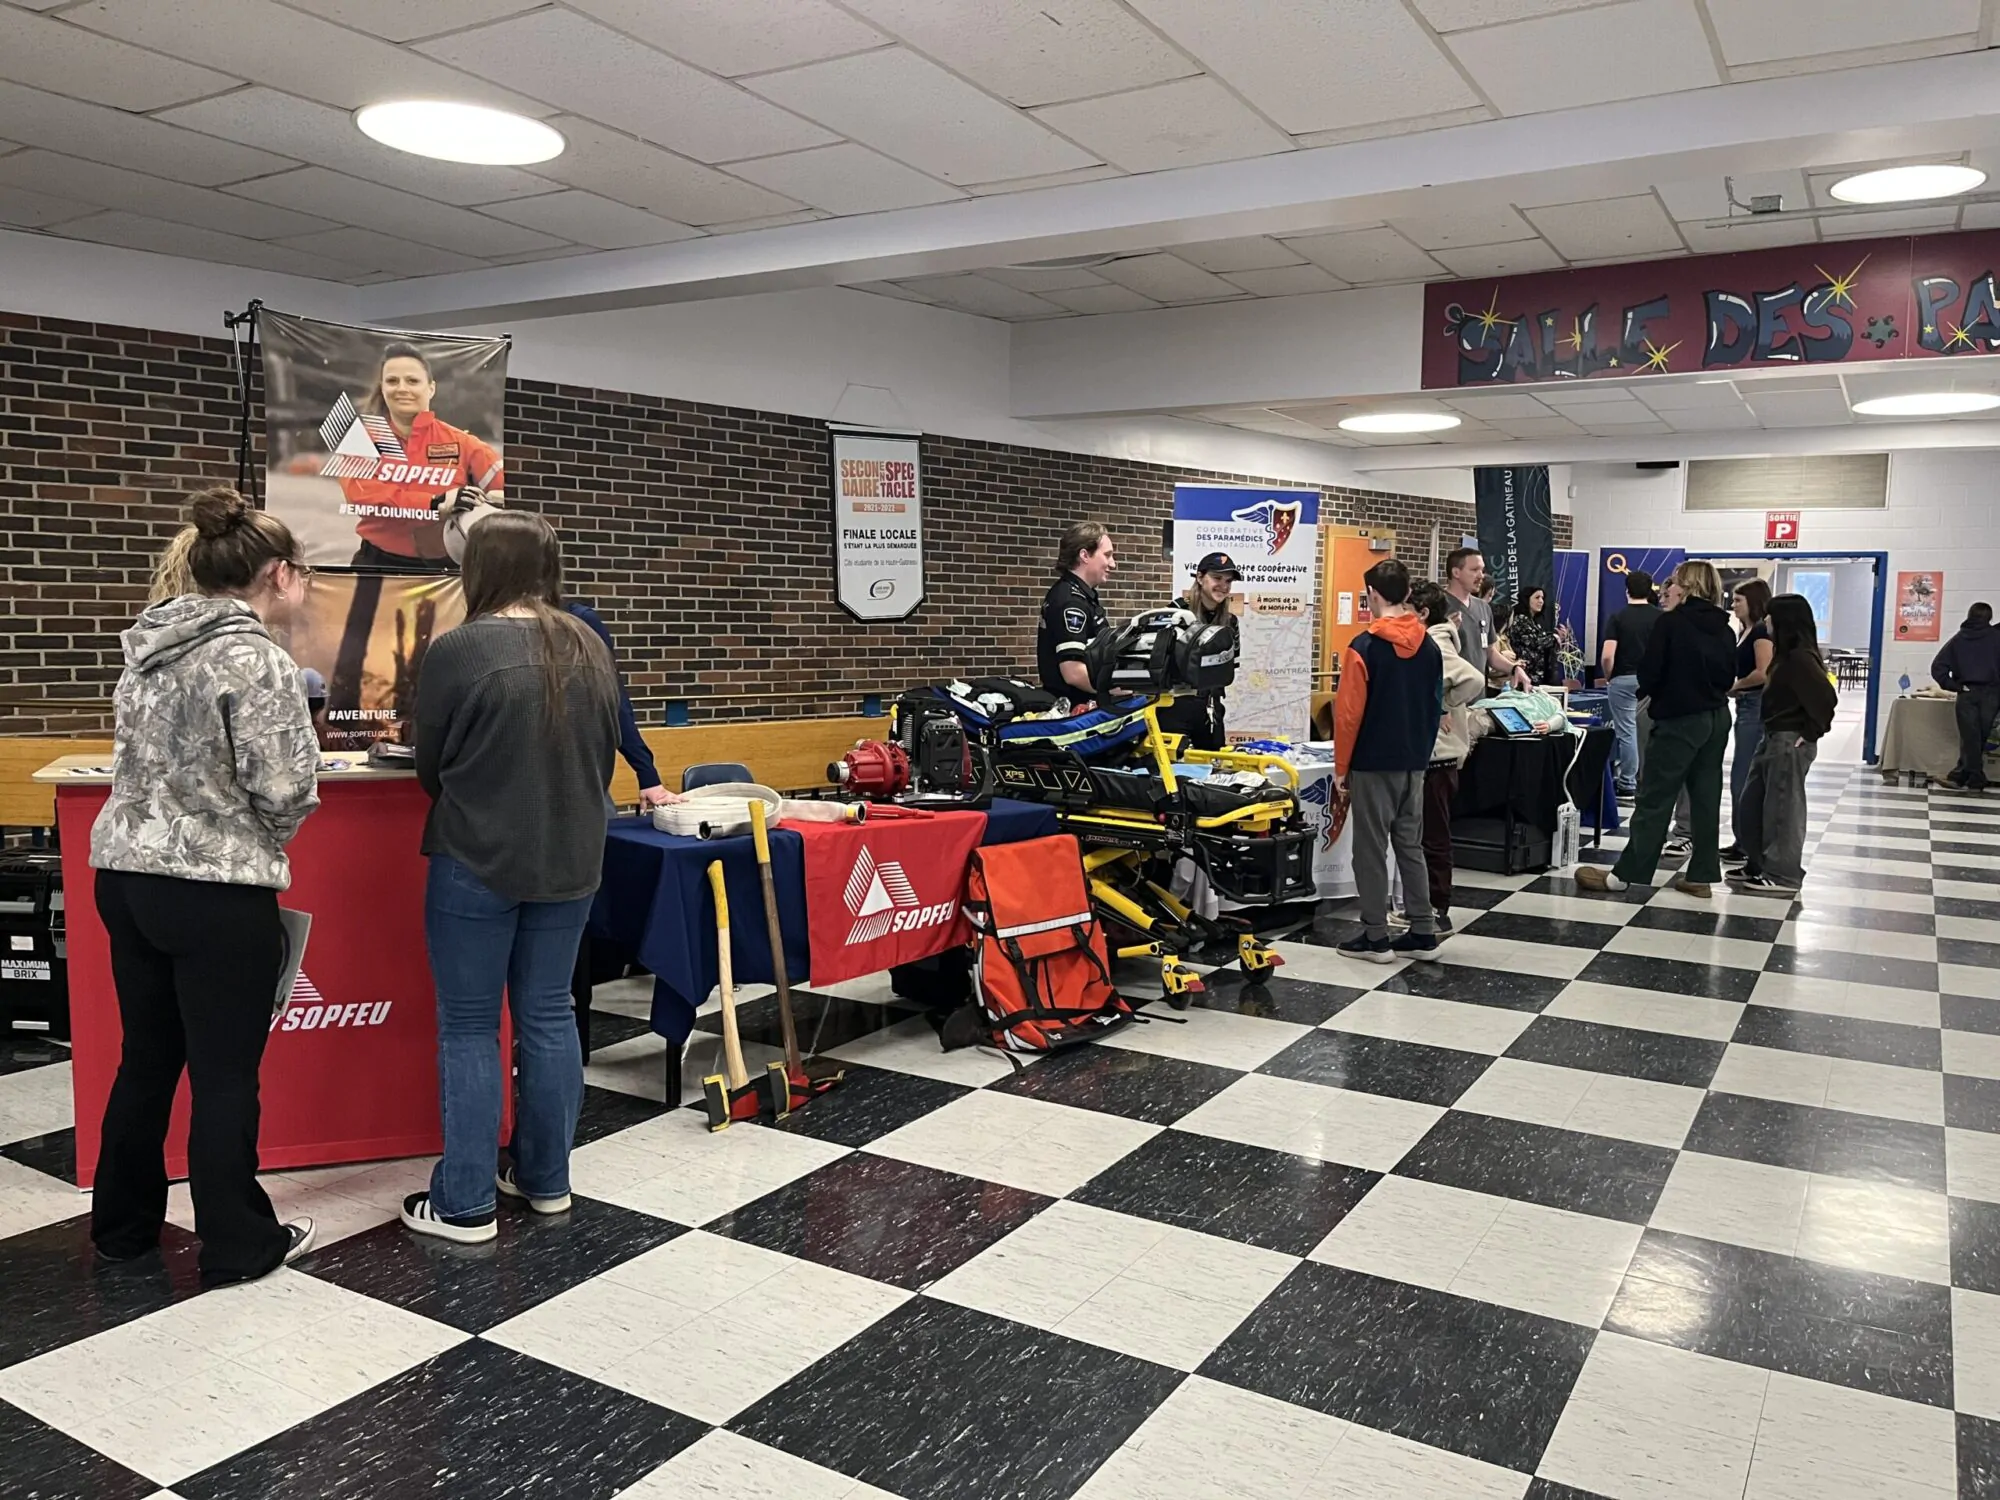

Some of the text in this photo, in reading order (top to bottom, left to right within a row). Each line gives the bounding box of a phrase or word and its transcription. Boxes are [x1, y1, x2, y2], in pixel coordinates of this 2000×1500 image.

[1702, 281, 1853, 368] DES
[378, 463, 456, 486] SOPFEU
[339, 503, 440, 521] #EMPLOIUNIQUE
[1769, 513, 1798, 522] SORTIE
[843, 529, 917, 540] FINALE LOCALE
[1196, 526, 1264, 534] COOPÉRATIVE
[1775, 522, 1792, 539] P
[1257, 562, 1307, 573] coopérative
[1246, 575, 1265, 583] bras
[1267, 575, 1297, 584] ouvert
[328, 710, 397, 720] #AVENTURE
[1005, 769, 1025, 779] XPS
[892, 898, 956, 933] SOPFEU
[1, 959, 50, 970] MAXIMUM
[14, 969, 38, 979] BRIX
[281, 1001, 392, 1031] SOPFEU
